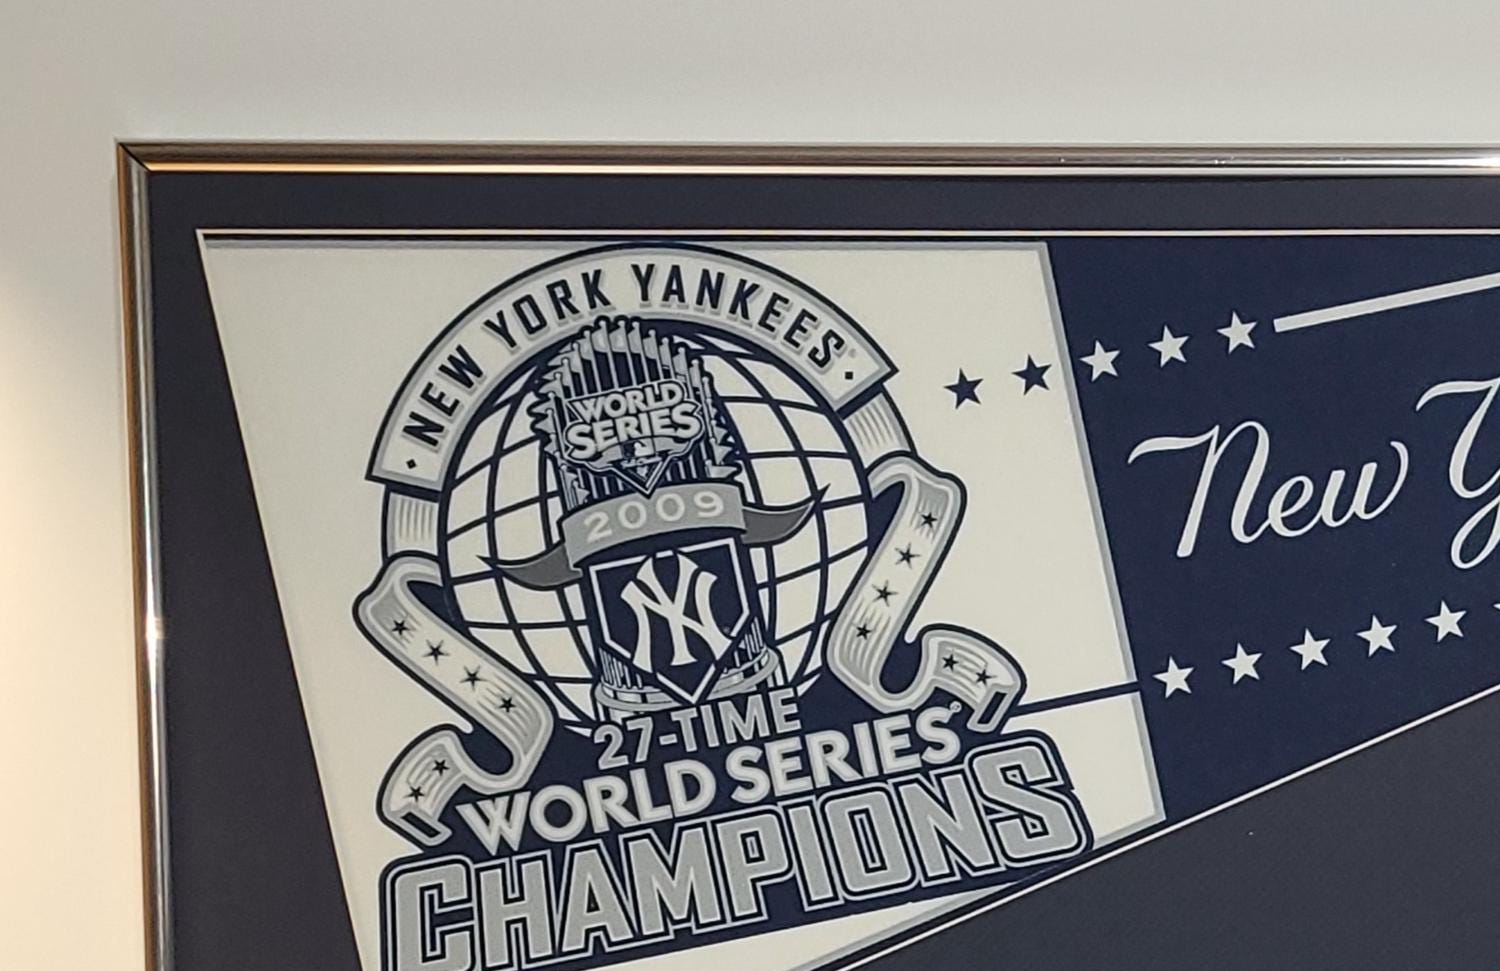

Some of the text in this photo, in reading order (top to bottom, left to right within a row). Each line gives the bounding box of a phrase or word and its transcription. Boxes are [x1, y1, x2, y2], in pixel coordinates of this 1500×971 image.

[403, 262, 846, 448] NEW YORK YANKEES
[572, 380, 684, 424] WORLD
[566, 401, 702, 460] SERIES
[583, 490, 725, 544] 2009
[1127, 420, 1410, 558] New
[620, 551, 733, 674] NY
[594, 687, 802, 770] 27-TIME
[456, 711, 962, 856] WORLD SERIES
